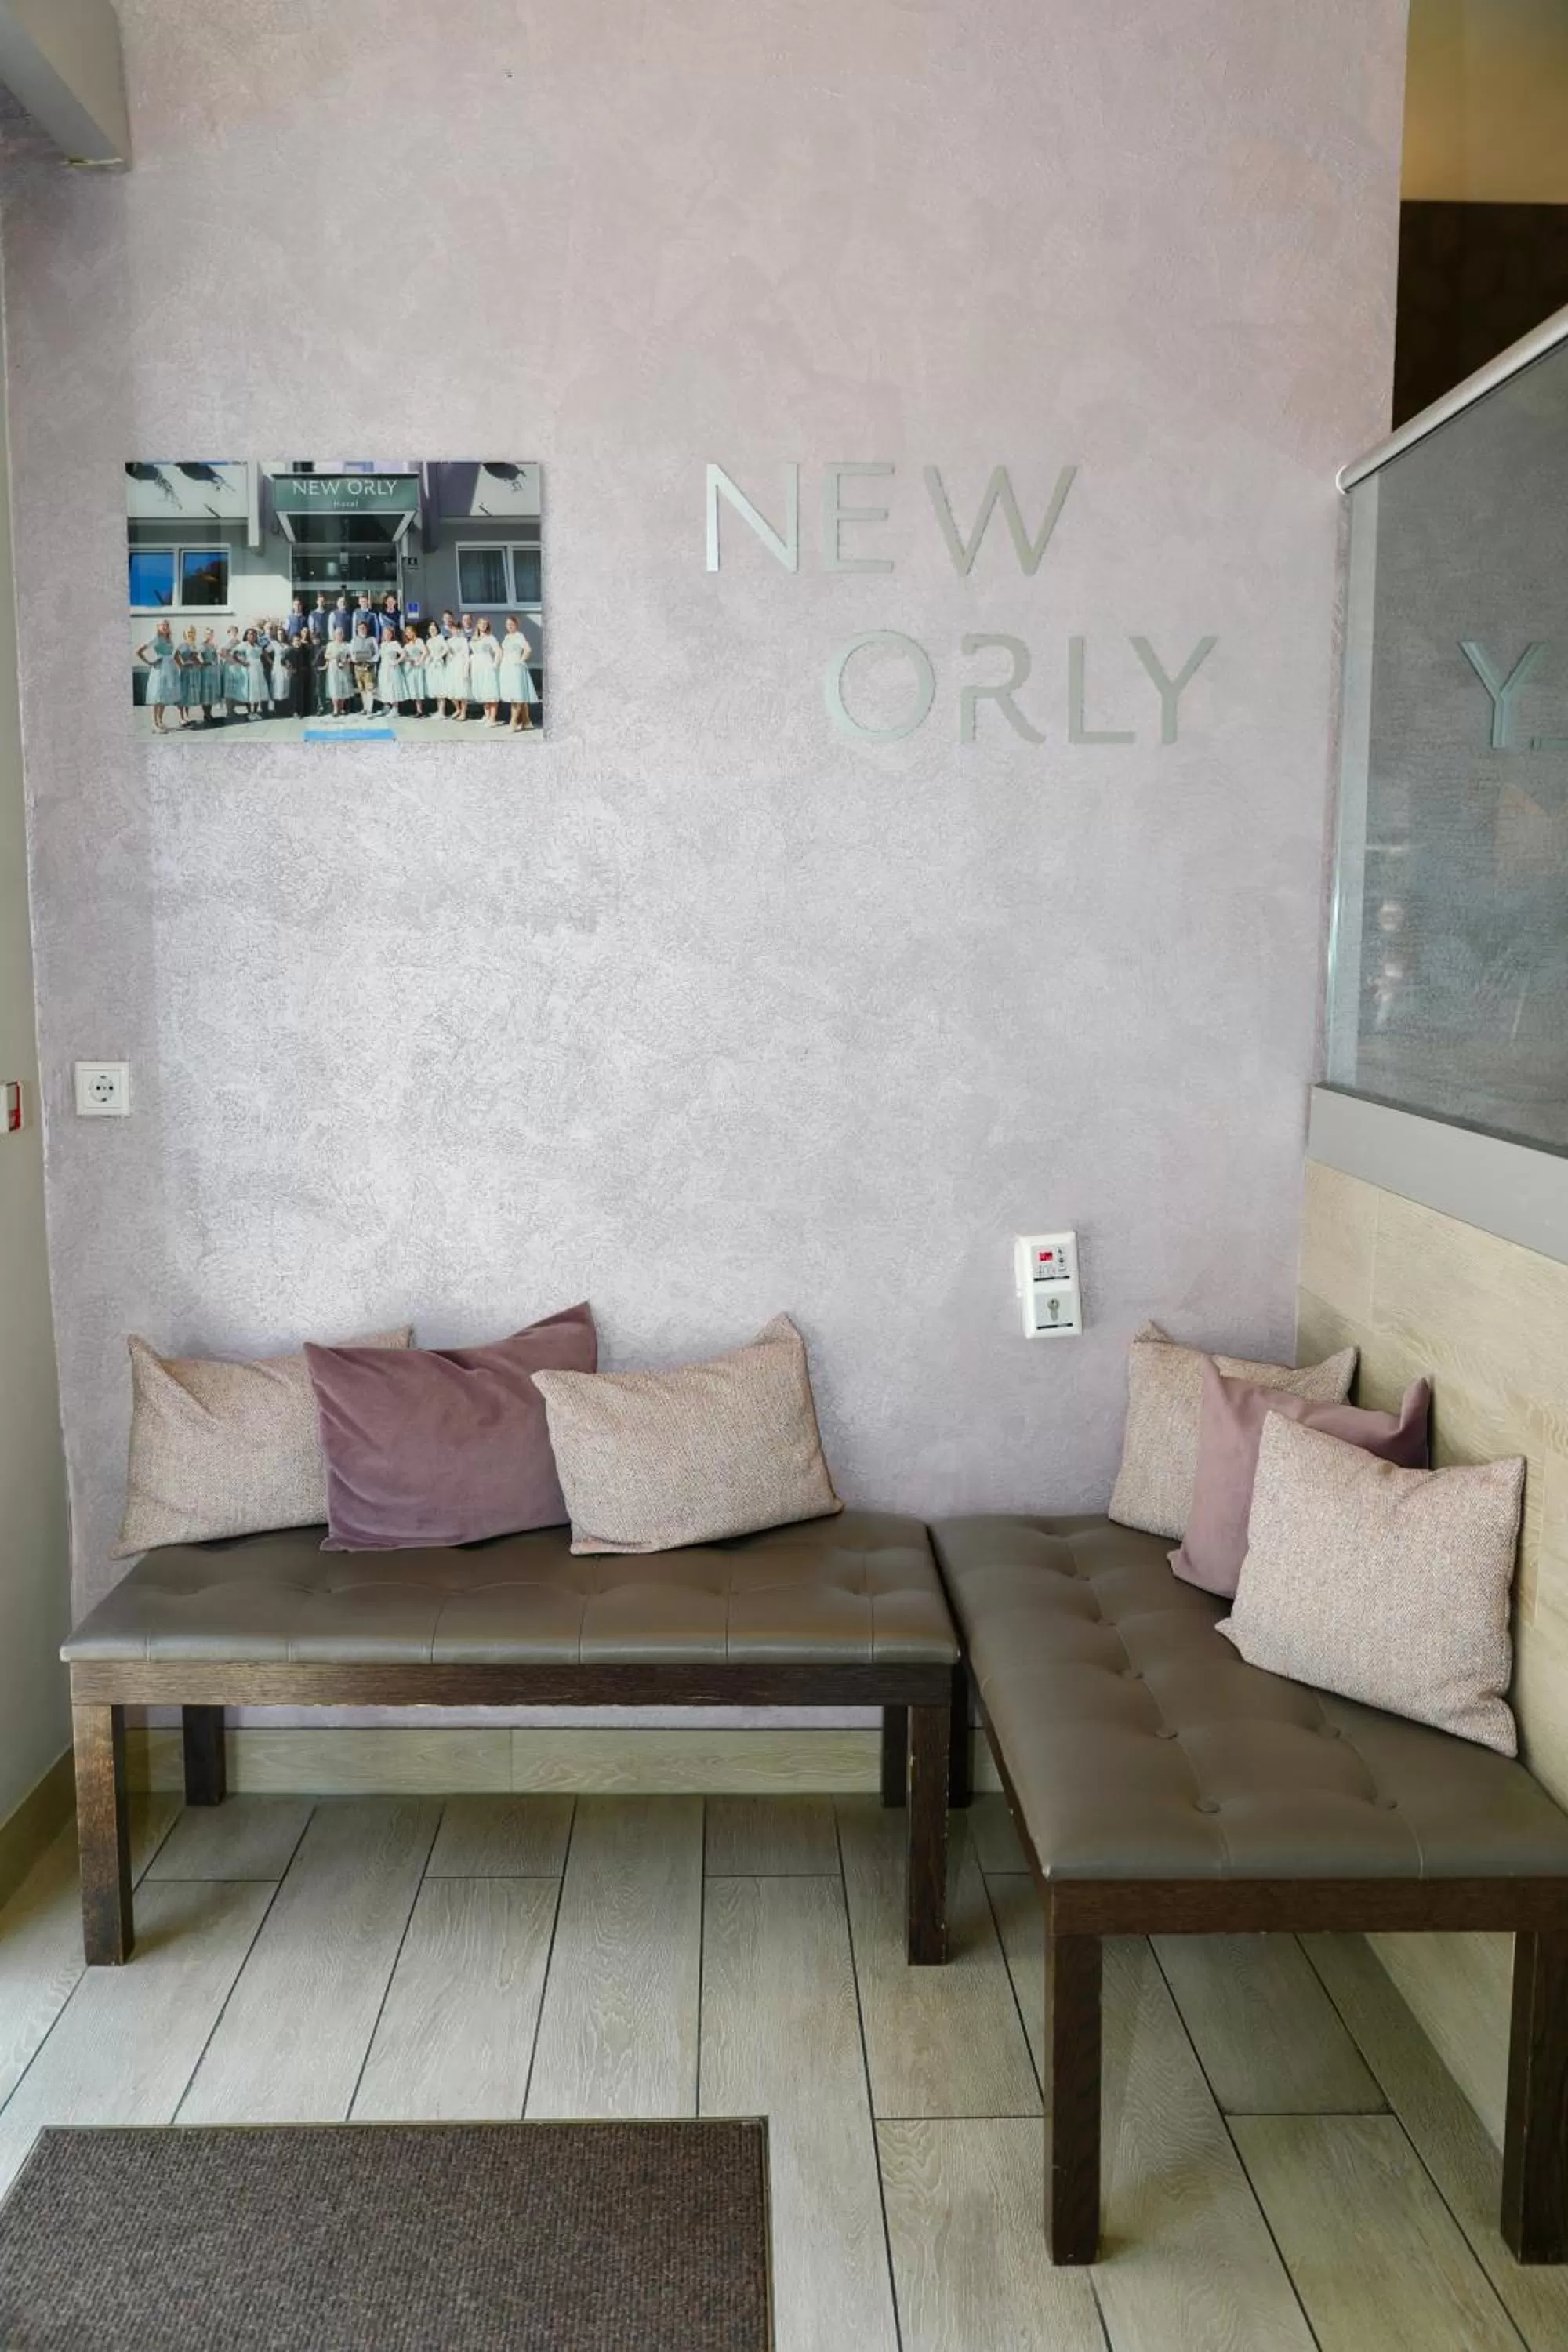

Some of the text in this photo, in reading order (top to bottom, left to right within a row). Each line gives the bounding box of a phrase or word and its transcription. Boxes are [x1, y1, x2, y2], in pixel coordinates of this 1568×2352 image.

[292, 479, 397, 495] NEW ORLY
[706, 462, 1077, 576] NEW
[824, 630, 1218, 744] ORLY
